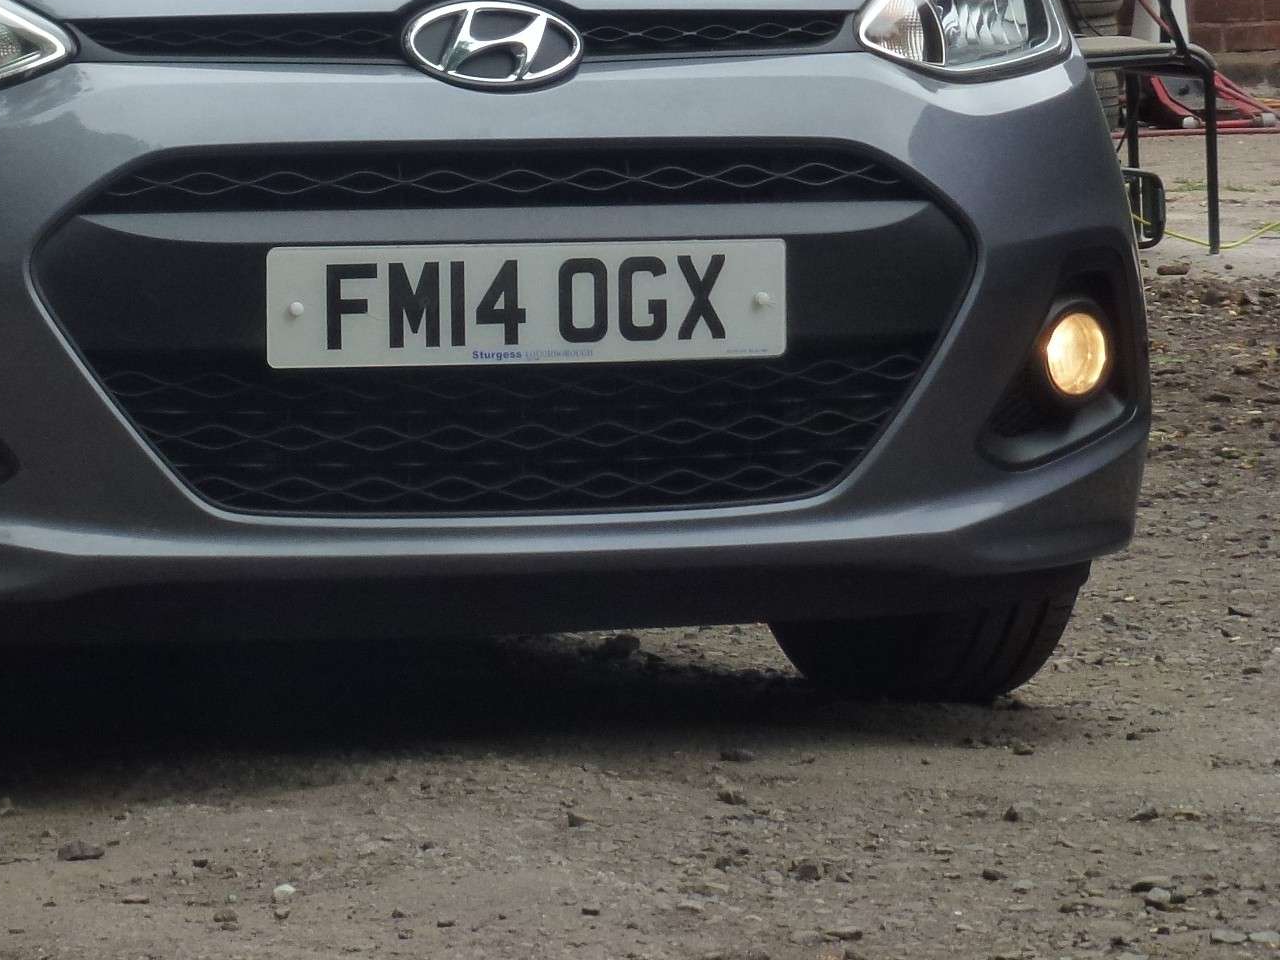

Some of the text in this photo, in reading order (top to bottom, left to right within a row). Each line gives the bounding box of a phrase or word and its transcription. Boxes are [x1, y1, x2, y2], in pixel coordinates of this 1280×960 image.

[325, 253, 727, 351] FM14 OGX
[472, 350, 522, 361] Sturgess
